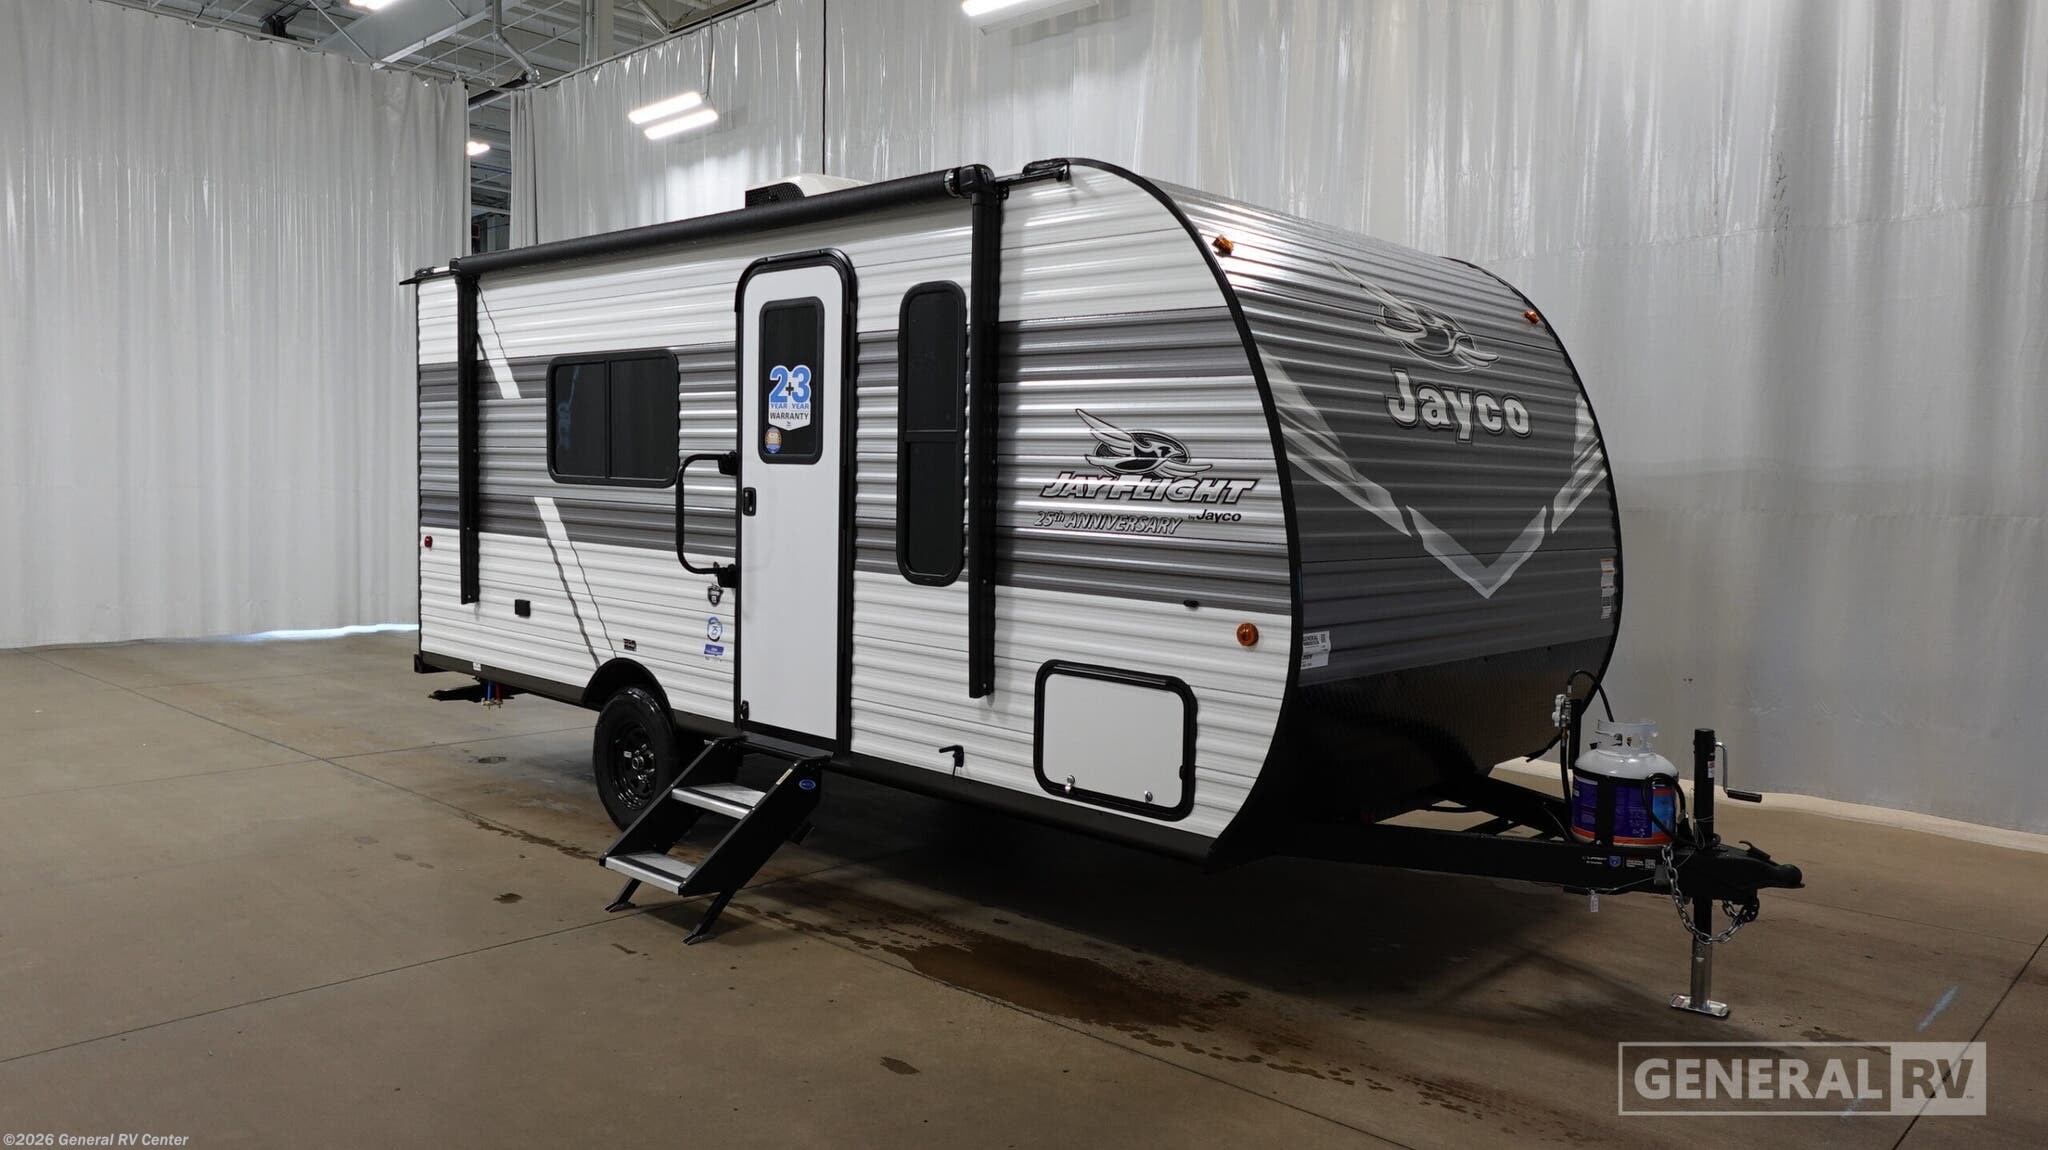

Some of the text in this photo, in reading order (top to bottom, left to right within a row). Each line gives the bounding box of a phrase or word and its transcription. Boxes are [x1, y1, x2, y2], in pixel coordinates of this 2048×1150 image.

[1385, 368, 1532, 443] Jayco
[770, 412, 809, 420] WARRANTY
[1034, 511, 1183, 535] 25th ANNIVERSARY
[1196, 508, 1242, 523] Jayco
